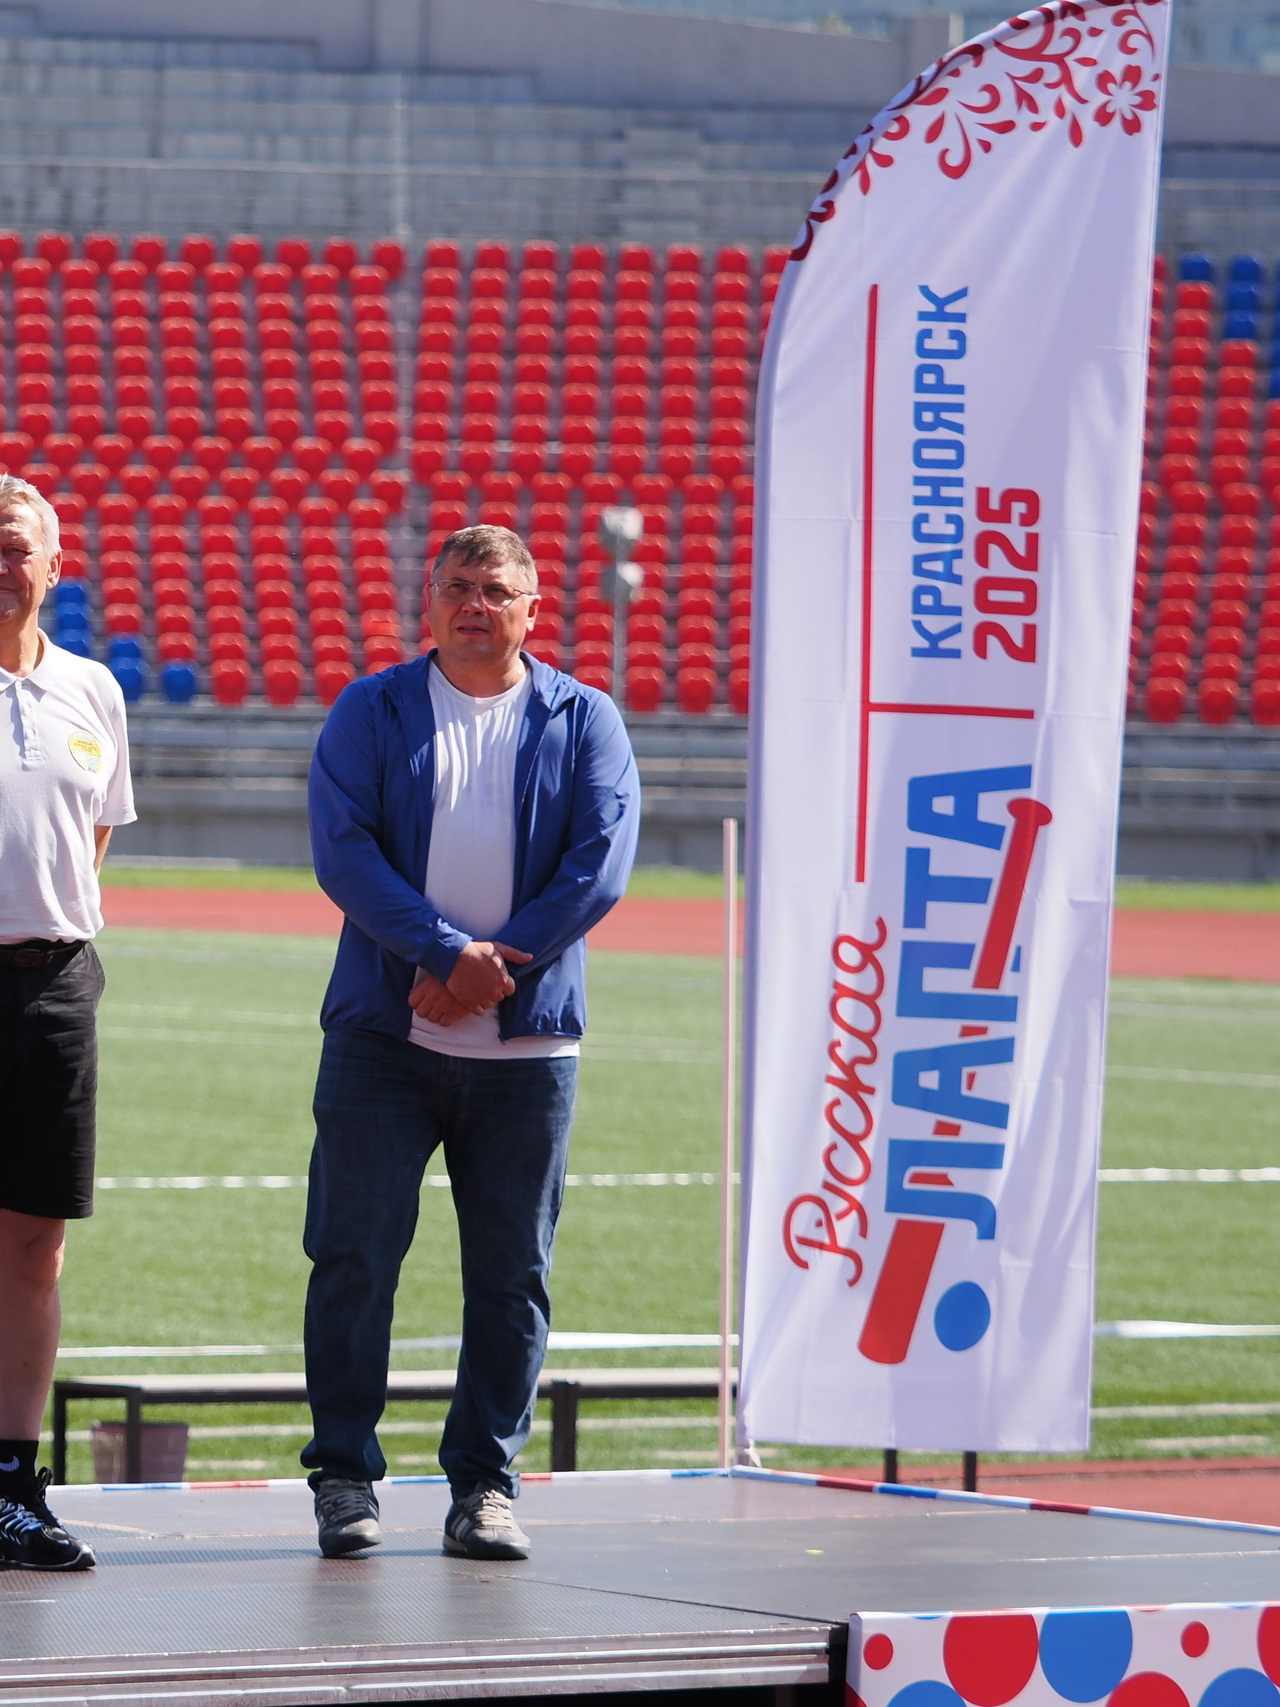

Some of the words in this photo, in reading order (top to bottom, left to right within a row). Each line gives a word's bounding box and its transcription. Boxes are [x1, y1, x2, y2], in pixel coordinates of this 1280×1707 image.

[910, 284, 969, 659] КРАСНОЯРСК
[972, 485, 1041, 664] 2025
[781, 914, 888, 1288] Русская
[884, 763, 1033, 1240] ЛАПТА
